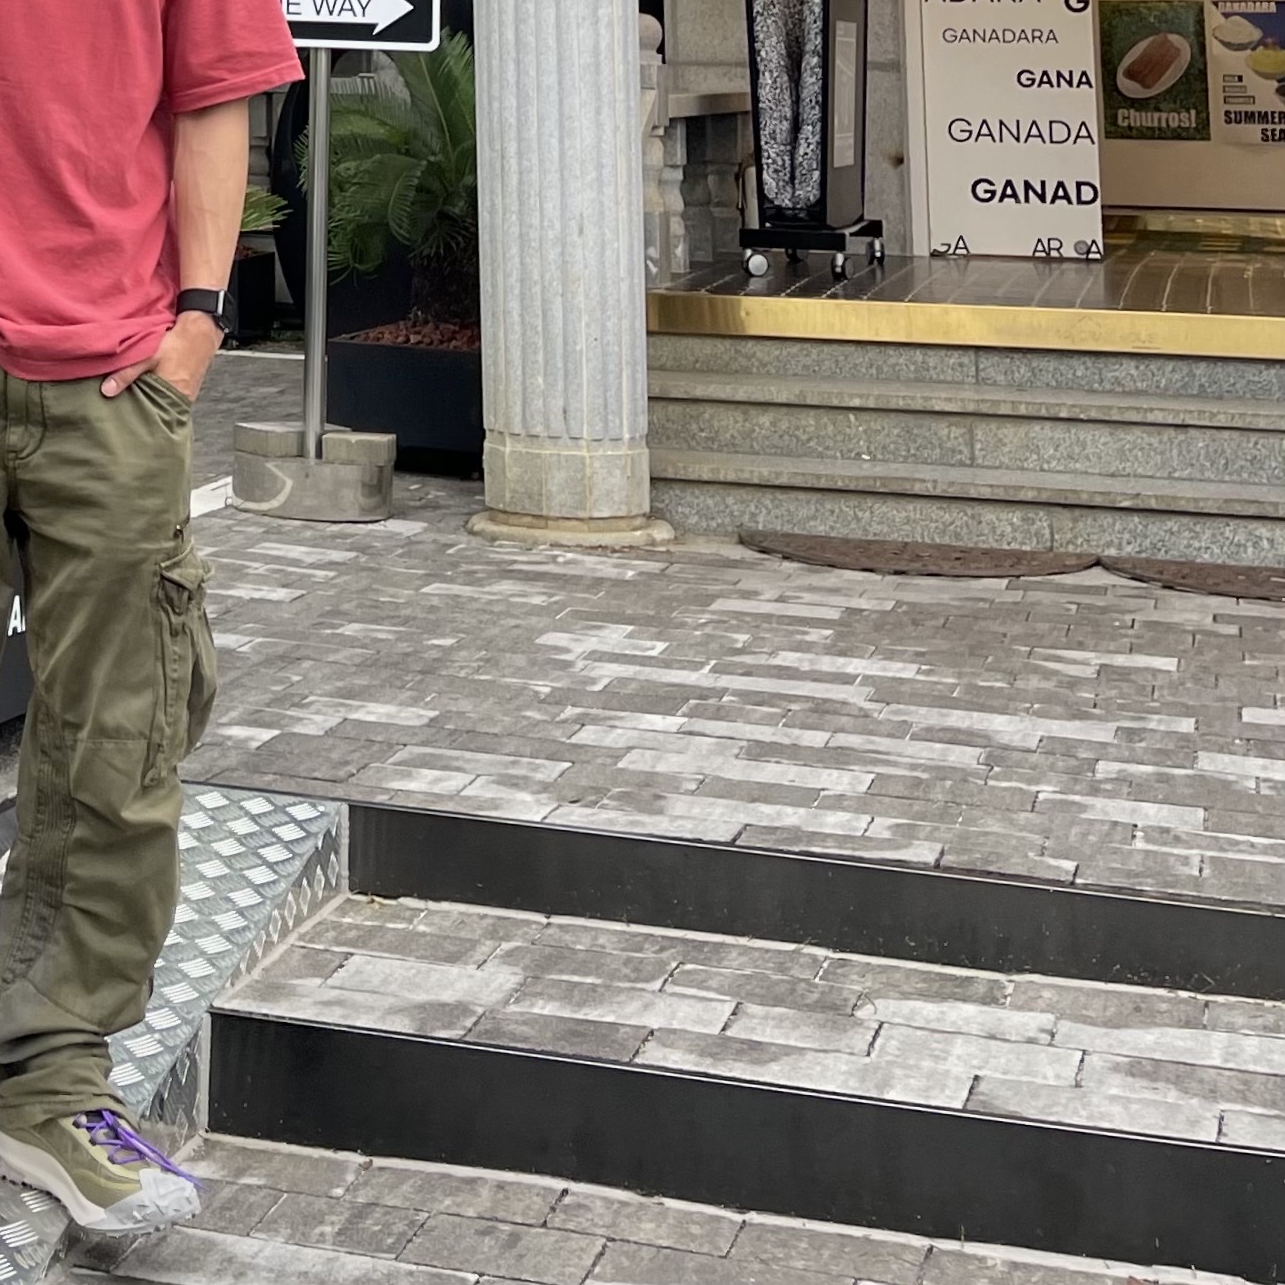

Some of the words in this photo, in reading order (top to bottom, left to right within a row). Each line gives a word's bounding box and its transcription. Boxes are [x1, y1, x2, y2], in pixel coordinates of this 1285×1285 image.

[942, 27, 1060, 44] GANADARA
[1017, 69, 1094, 89] GANA
[1117, 108, 1197, 128] Churros!
[948, 118, 1096, 145] GANADA
[971, 178, 1100, 206] GANAD
